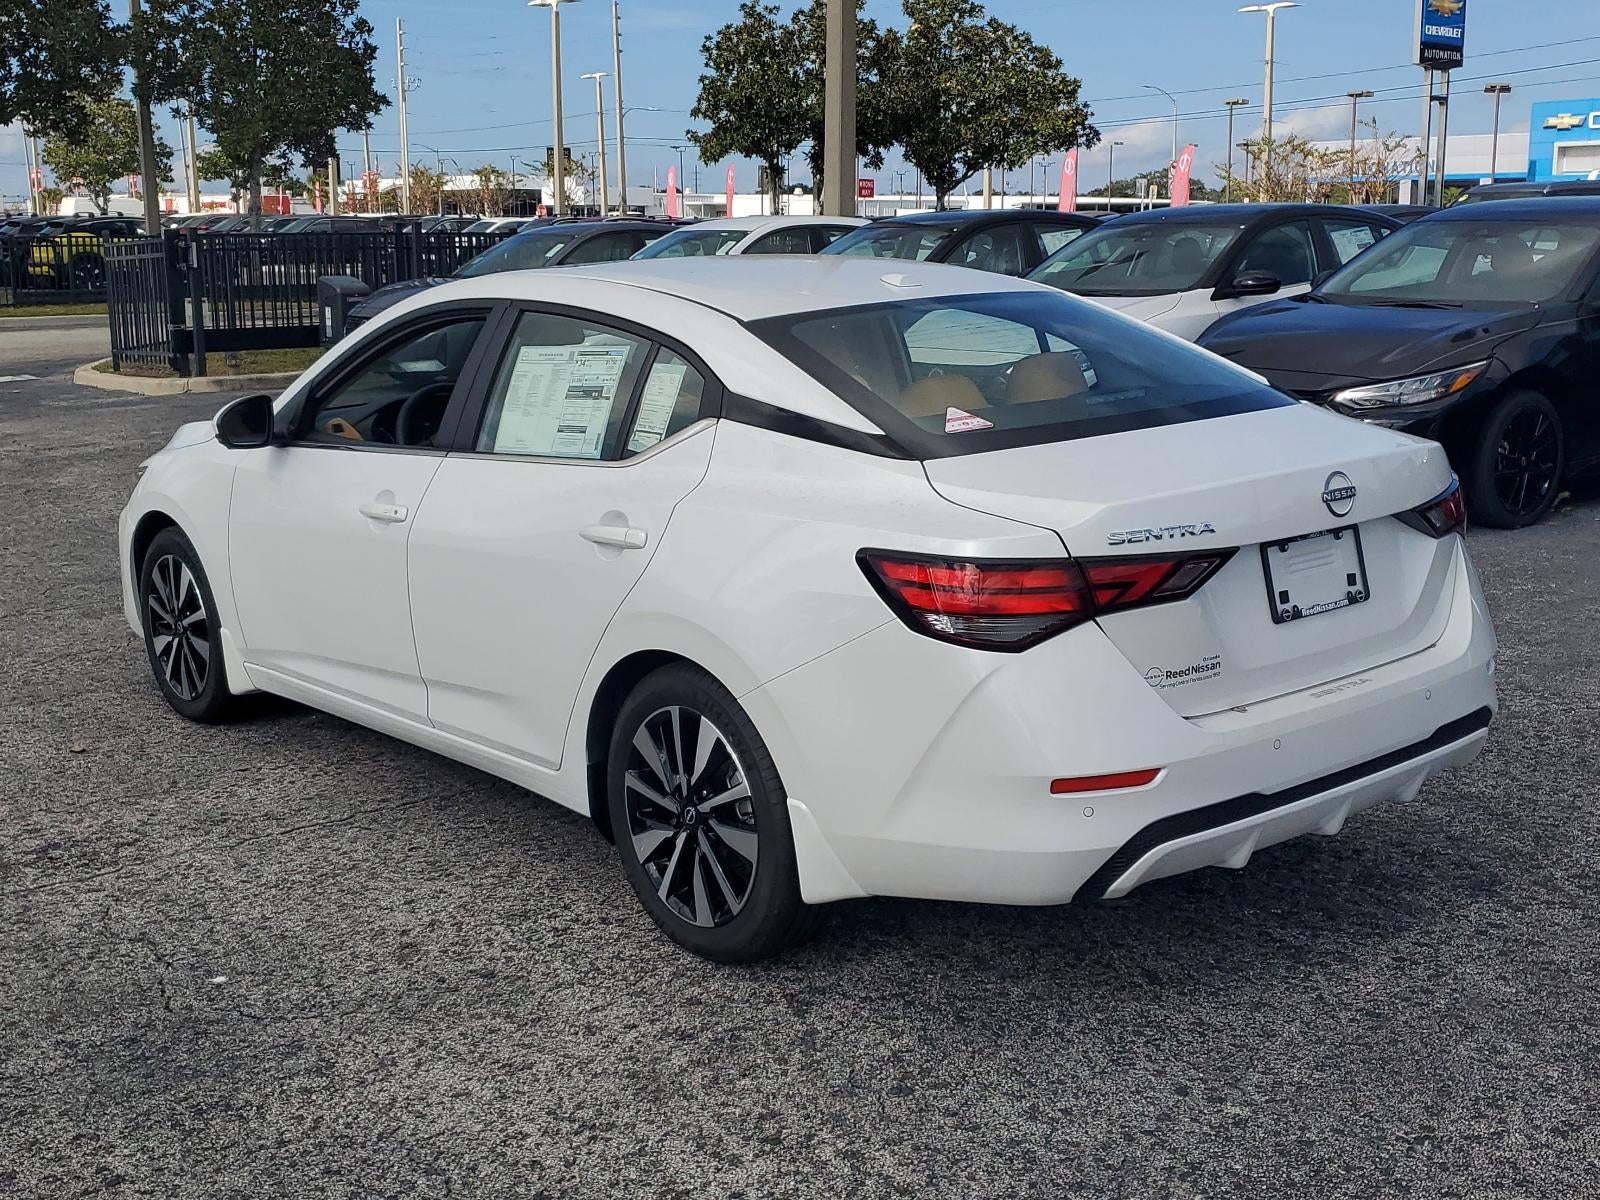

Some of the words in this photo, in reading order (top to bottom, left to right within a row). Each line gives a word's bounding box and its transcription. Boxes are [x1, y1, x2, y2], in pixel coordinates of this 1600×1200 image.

[1425, 25, 1462, 38] CHEVROLET
[1424, 49, 1461, 60] AUTONATION
[1322, 486, 1357, 502] NISSAN
[1107, 520, 1216, 546] SENTRA
[1301, 599, 1349, 616] ReedNissan.com
